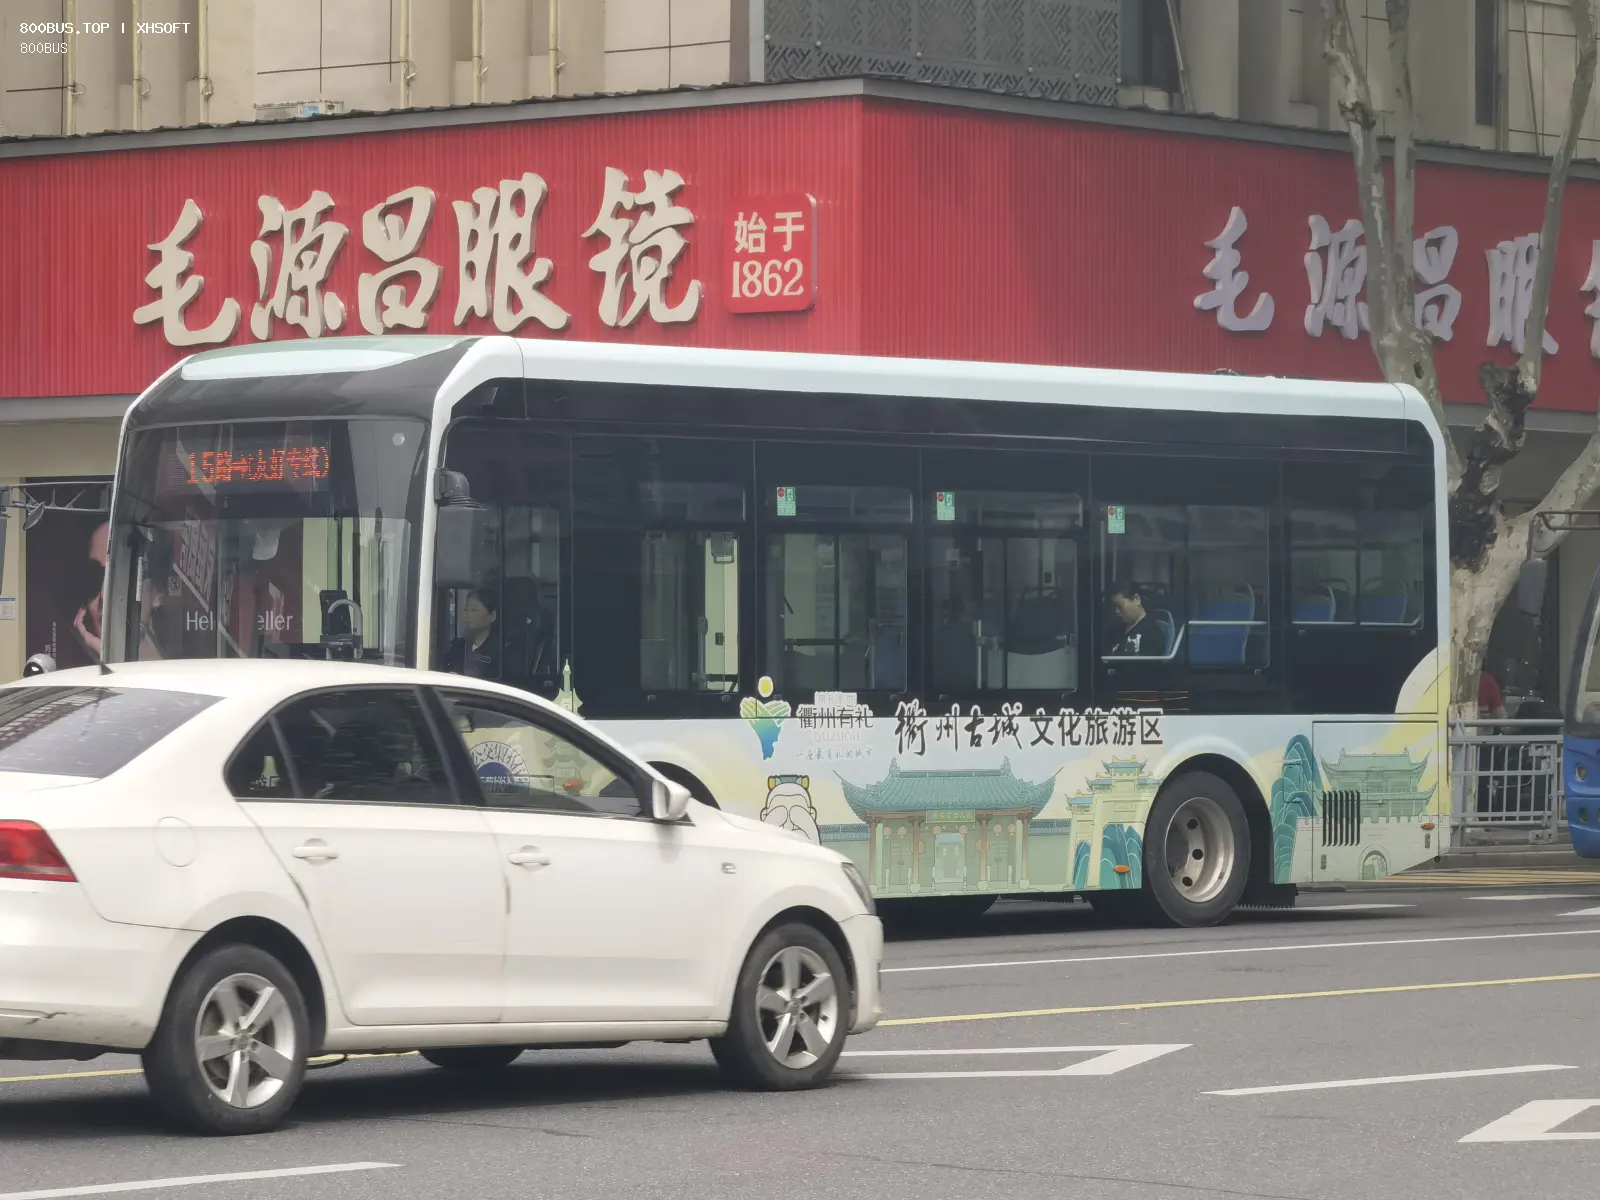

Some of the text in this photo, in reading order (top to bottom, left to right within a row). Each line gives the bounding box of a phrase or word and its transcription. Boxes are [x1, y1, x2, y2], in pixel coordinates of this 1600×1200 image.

[733, 211, 805, 253] 始于
[133, 165, 704, 347] 毛源昌眼镜
[731, 258, 805, 298] 1862
[1193, 205, 1600, 359] 毛源昌眼
[186, 611, 294, 631] Hel eller
[800, 706, 874, 729] 衢州有礼
[813, 731, 861, 742] QUZHOU
